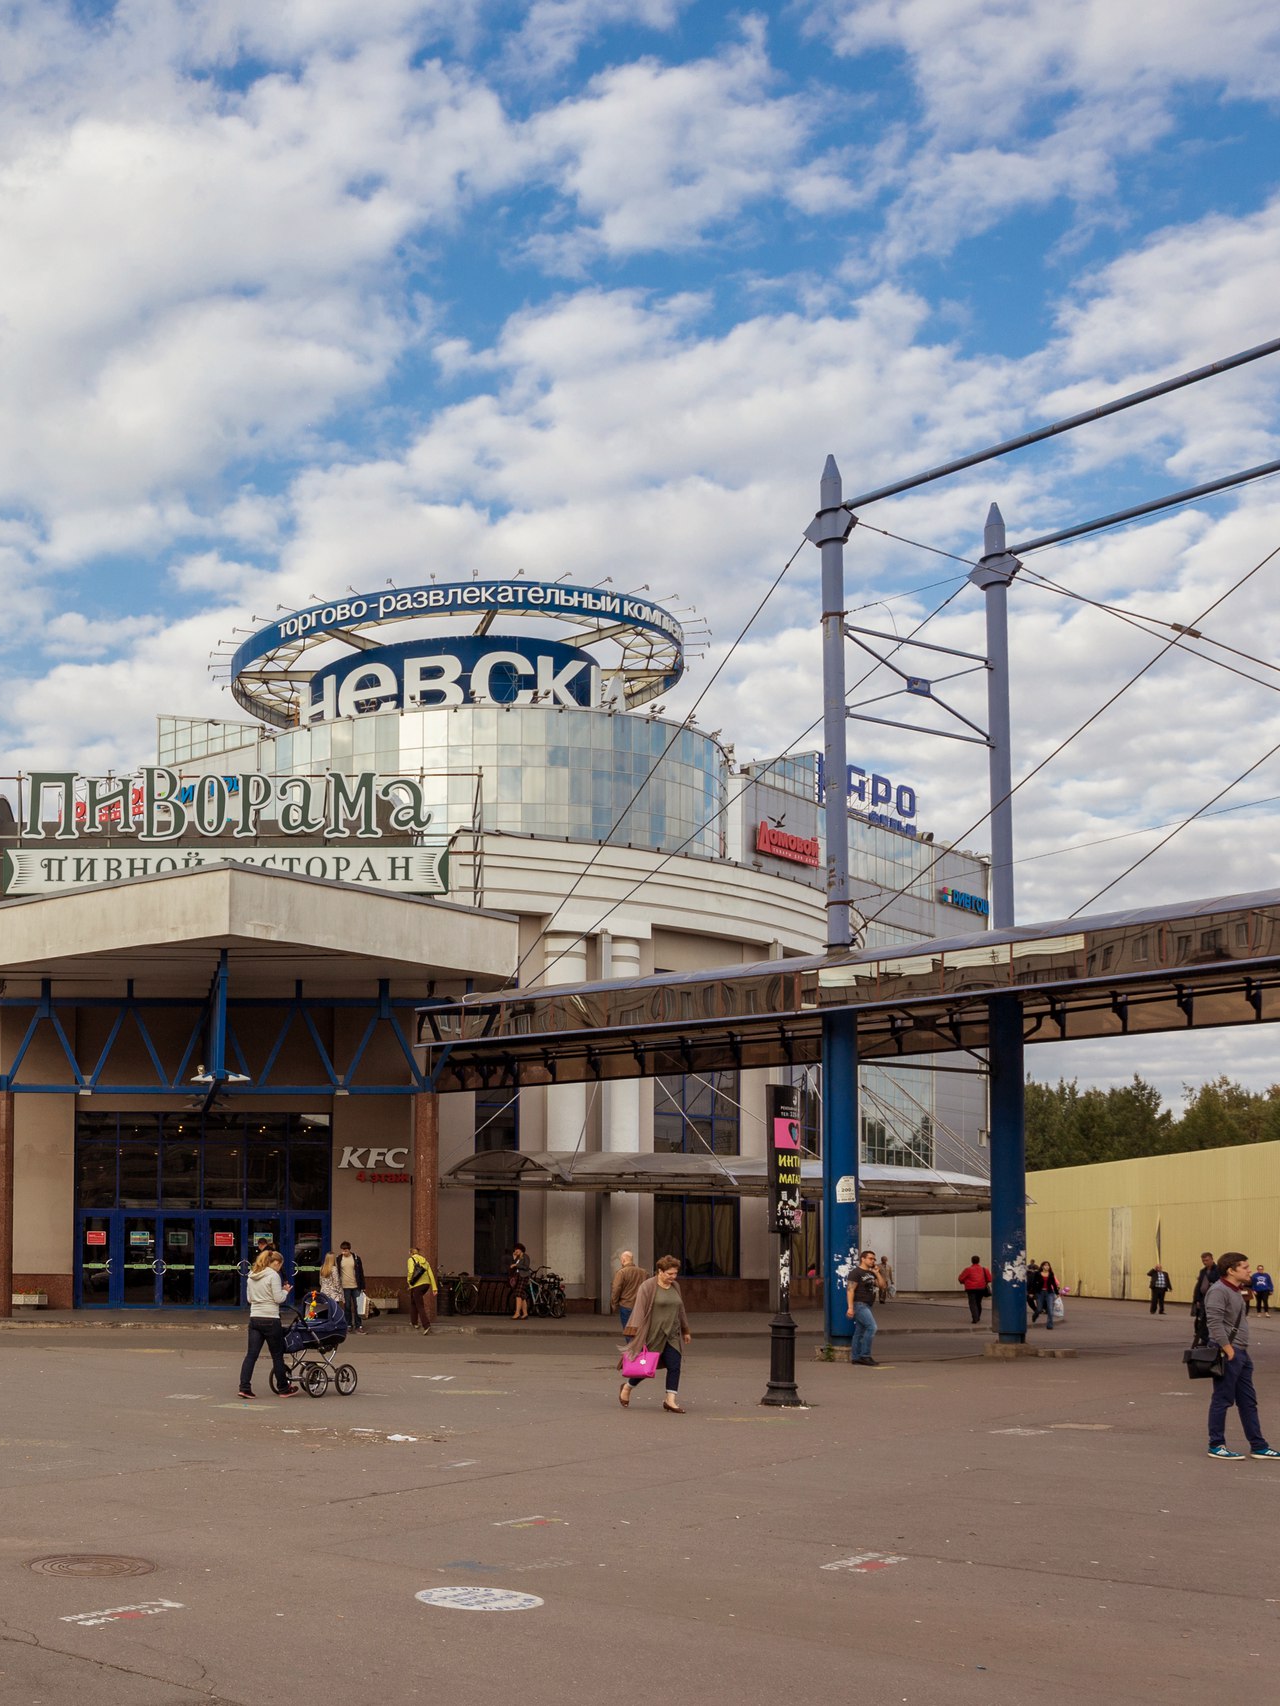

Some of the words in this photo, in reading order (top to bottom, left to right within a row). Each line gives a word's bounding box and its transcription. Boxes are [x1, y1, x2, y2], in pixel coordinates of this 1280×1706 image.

[278, 582, 619, 639] торгово-развлекательный
[337, 1146, 409, 1169] KFC
[356, 1171, 367, 1183] 4
[370, 1173, 410, 1183] этаж
